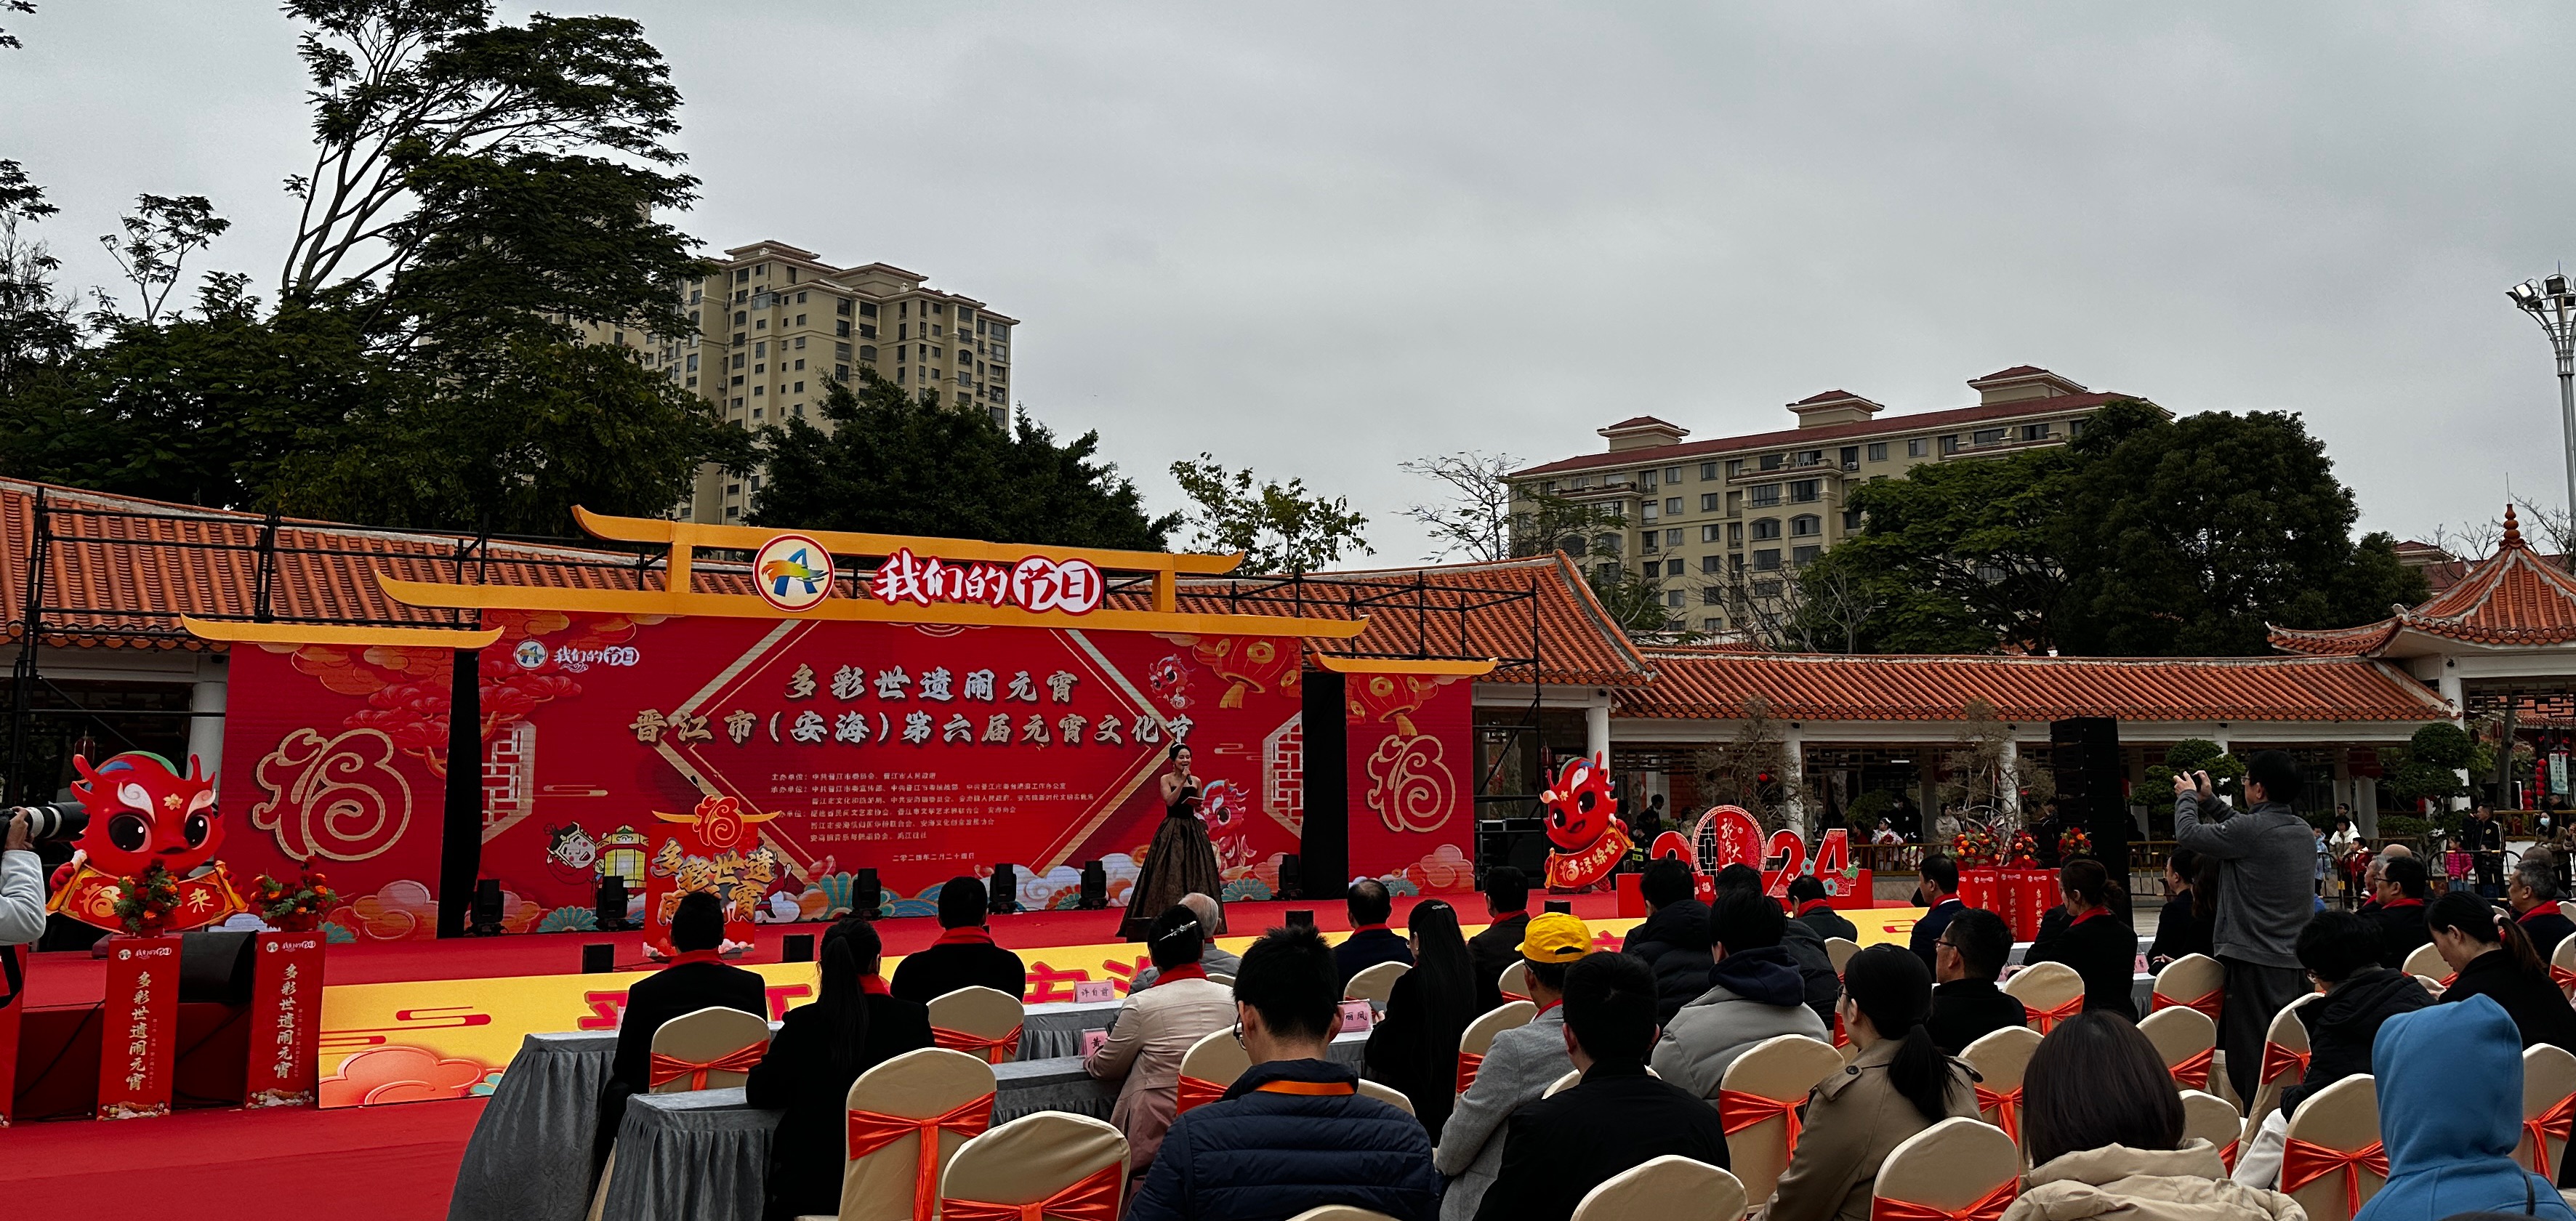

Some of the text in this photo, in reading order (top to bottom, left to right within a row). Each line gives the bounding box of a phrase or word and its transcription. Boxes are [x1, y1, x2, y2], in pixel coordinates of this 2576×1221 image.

[873, 548, 1100, 615] 我们的节日
[553, 645, 640, 666] 我们的节日
[784, 663, 1078, 703] 多彩世遗闹元宵
[629, 709, 1194, 744] 晋江市（安海）第六届元宵文化节
[187, 888, 214, 914] 来
[126, 971, 152, 1091] 多彩世遗闹元宵
[273, 963, 299, 1079] 多彩世遗闹元宵
